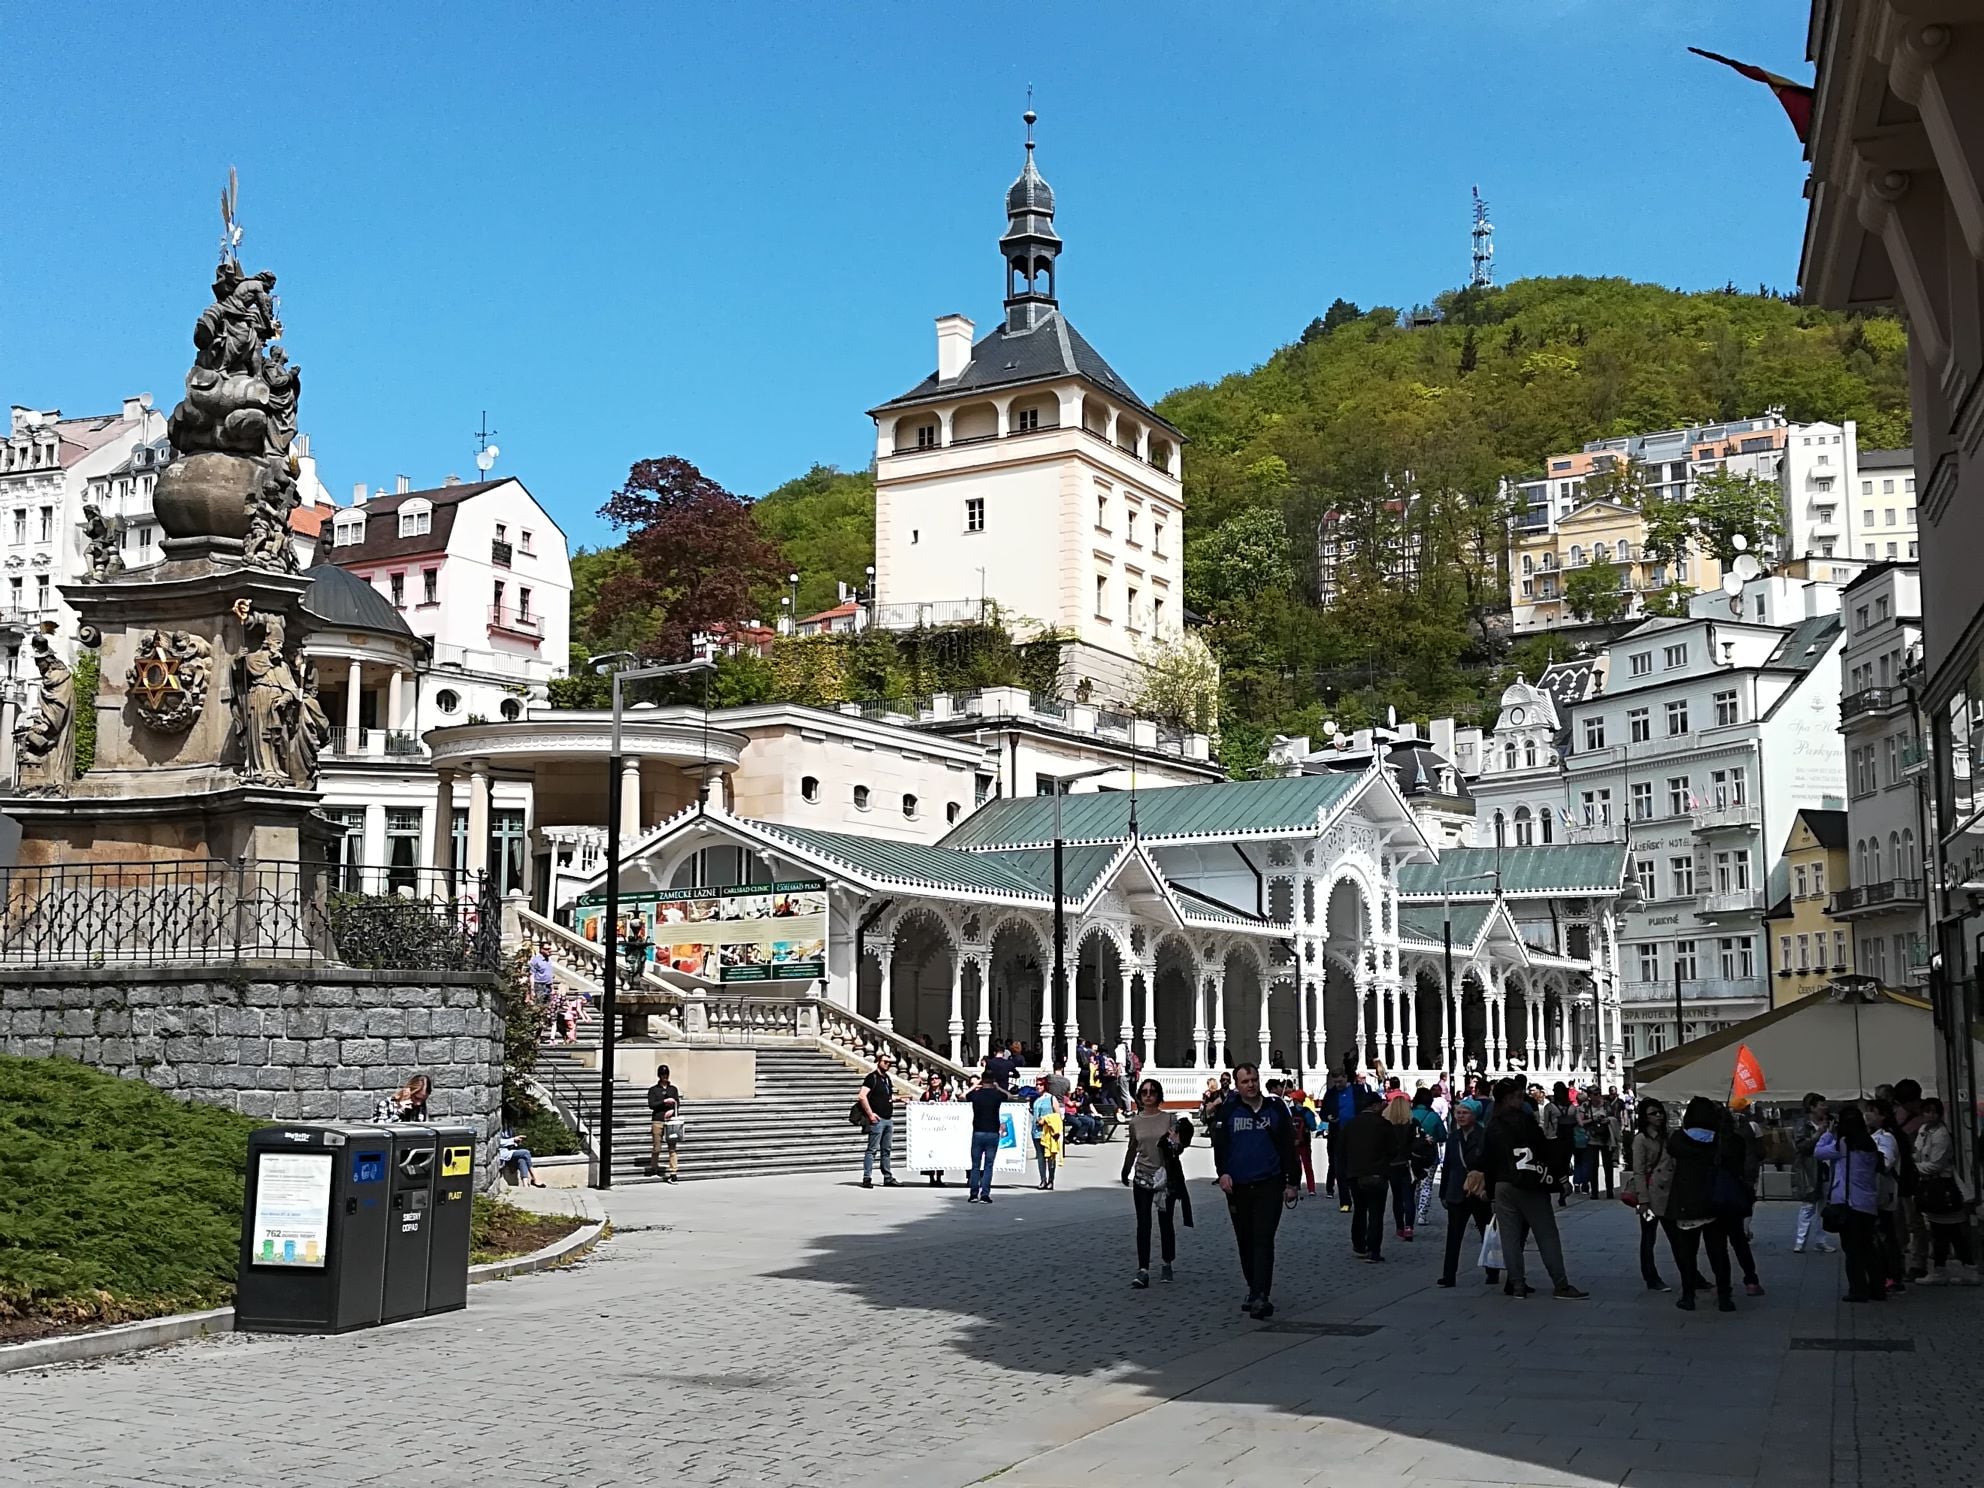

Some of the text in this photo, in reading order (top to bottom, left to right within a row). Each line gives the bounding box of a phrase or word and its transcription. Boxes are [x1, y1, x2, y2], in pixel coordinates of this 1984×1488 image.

[750, 884, 770, 892] CLINIC
[1624, 1010, 1640, 1020] SPA
[1642, 1009, 1668, 1020] HOTEL
[1513, 1147, 1553, 1184] 2%
[448, 1191, 463, 1201] PLAST
